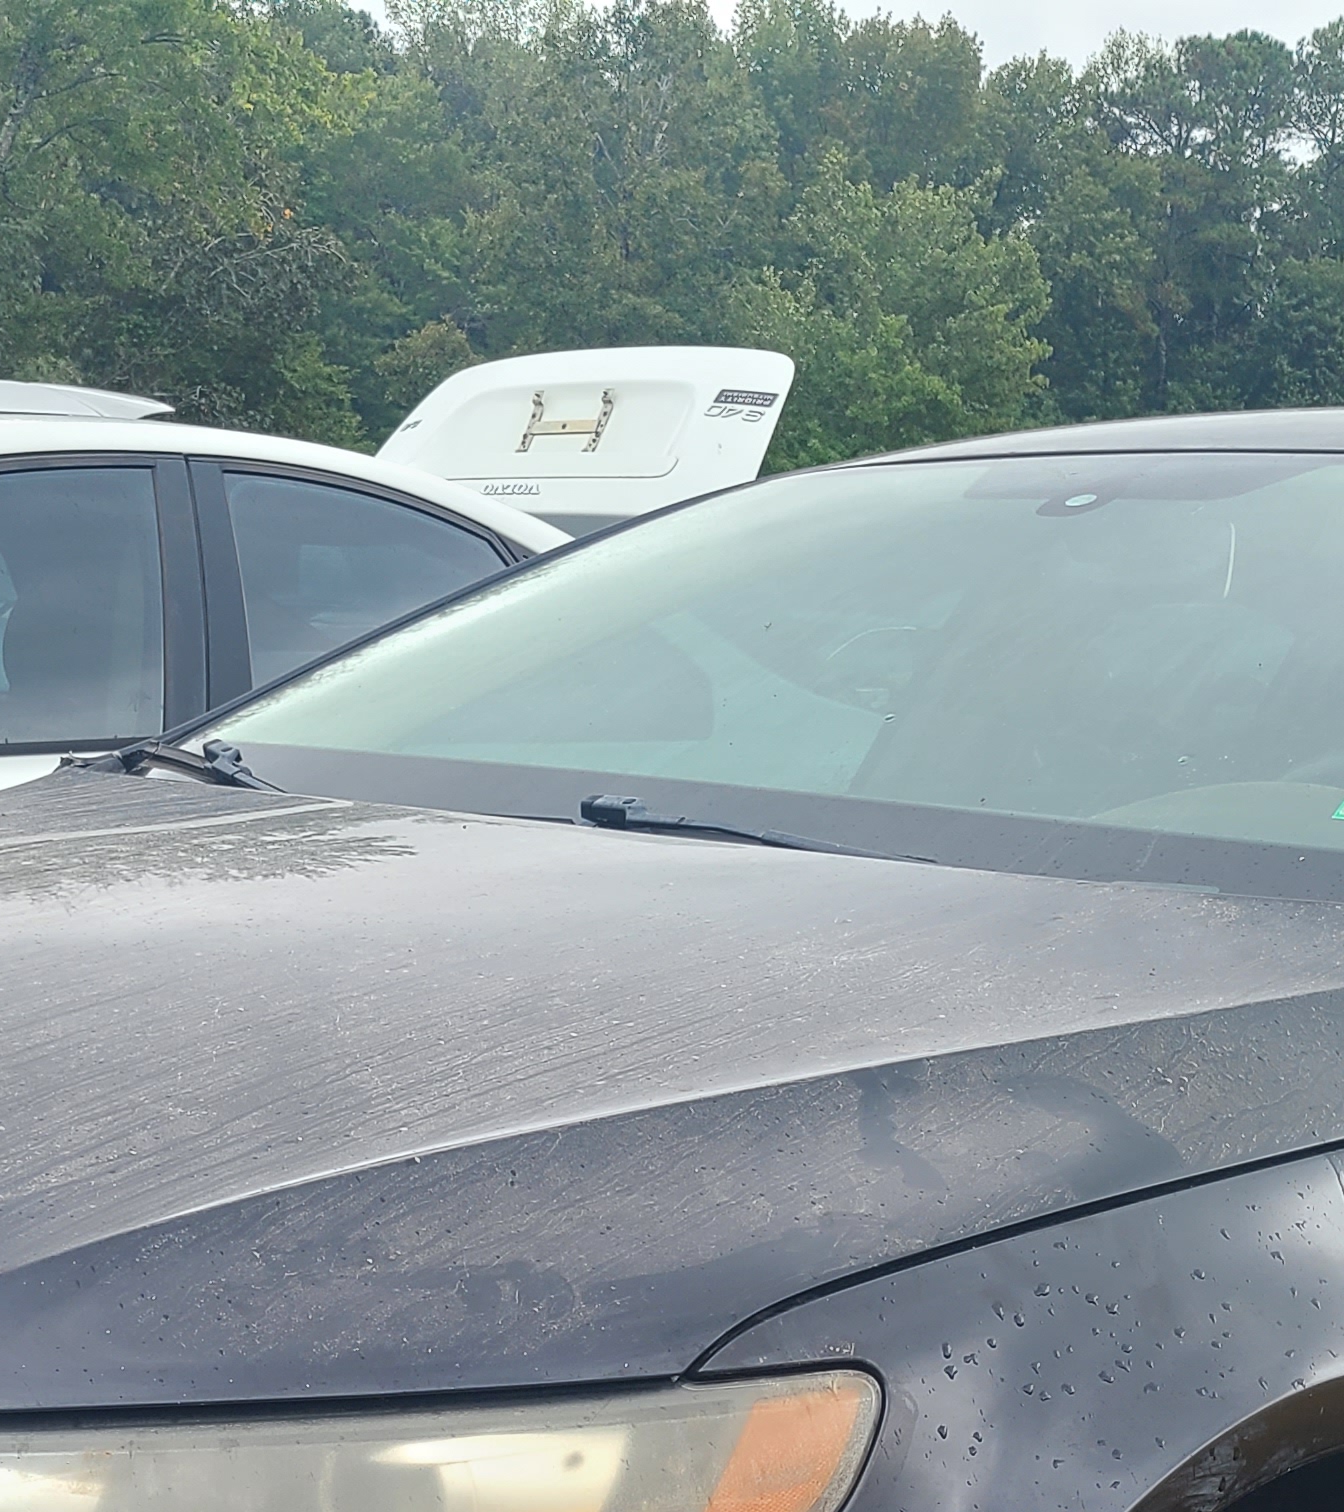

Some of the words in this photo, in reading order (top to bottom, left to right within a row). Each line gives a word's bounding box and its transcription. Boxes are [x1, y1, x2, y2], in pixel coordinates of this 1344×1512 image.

[719, 396, 771, 406] PRIORITY
[704, 405, 766, 423] S40
[480, 483, 541, 496] VOLVO
